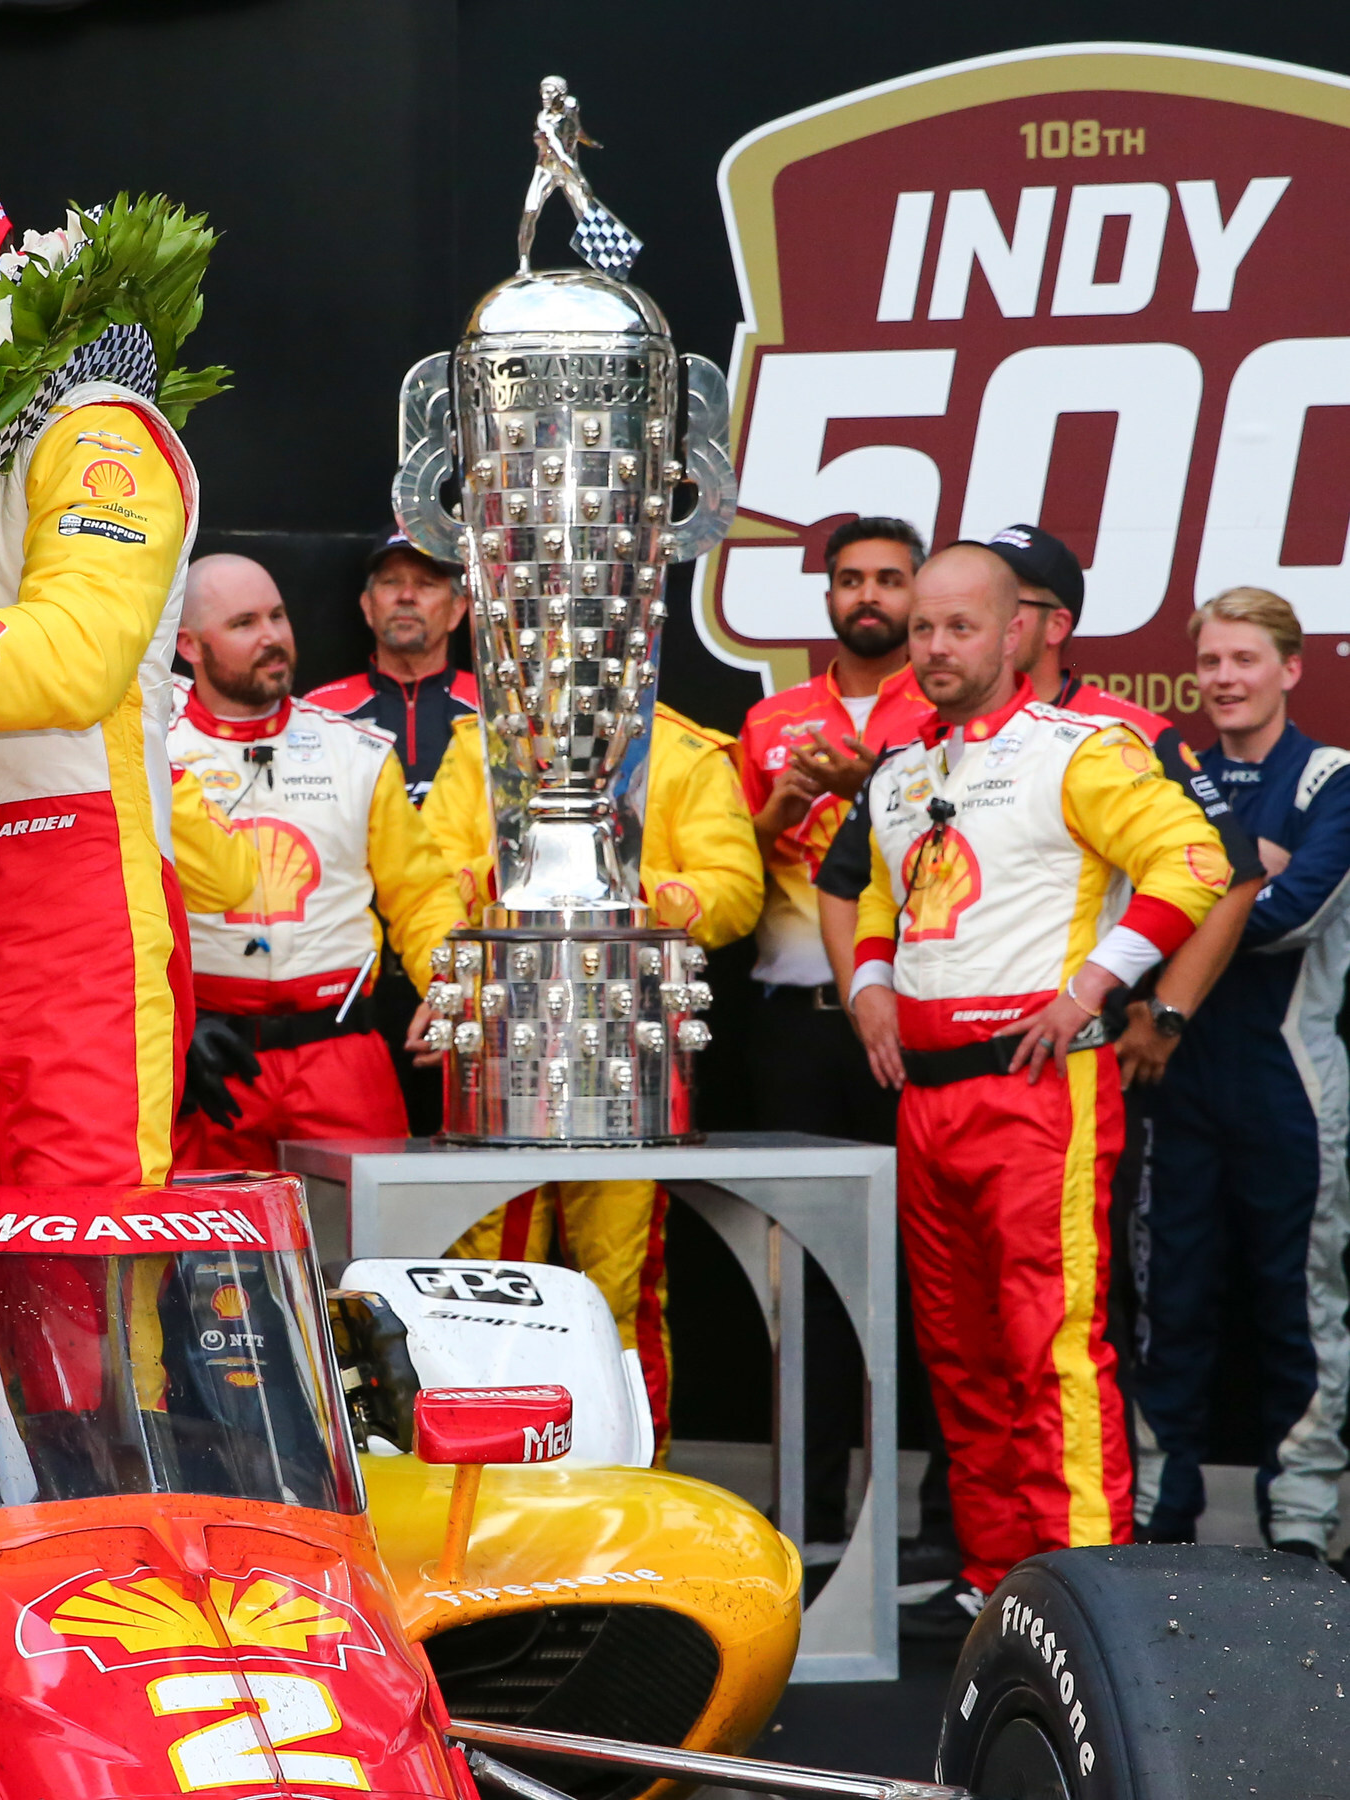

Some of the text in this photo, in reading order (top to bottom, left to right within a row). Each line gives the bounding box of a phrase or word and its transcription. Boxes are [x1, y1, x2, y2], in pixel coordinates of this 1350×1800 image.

[1020, 119, 1146, 160] 108TH
[876, 176, 1292, 322] INDY
[722, 336, 1350, 640] 500
[94, 503, 148, 522] allagher
[82, 519, 145, 542] CHAMPION
[282, 774, 333, 786] verizon
[966, 779, 1014, 792] verizon
[284, 792, 339, 803] HITACHI
[961, 796, 1016, 810] HITACHI
[951, 1008, 1024, 1023] RUPPERT
[411, 1269, 538, 1301] PPG
[423, 1310, 569, 1334] Snap-on
[229, 1334, 265, 1348] NTT
[433, 1389, 557, 1401] SIEMENS
[424, 1567, 665, 1608] Firestone
[1001, 1595, 1096, 1777] Firestone
[145, 1671, 373, 1794] 2
